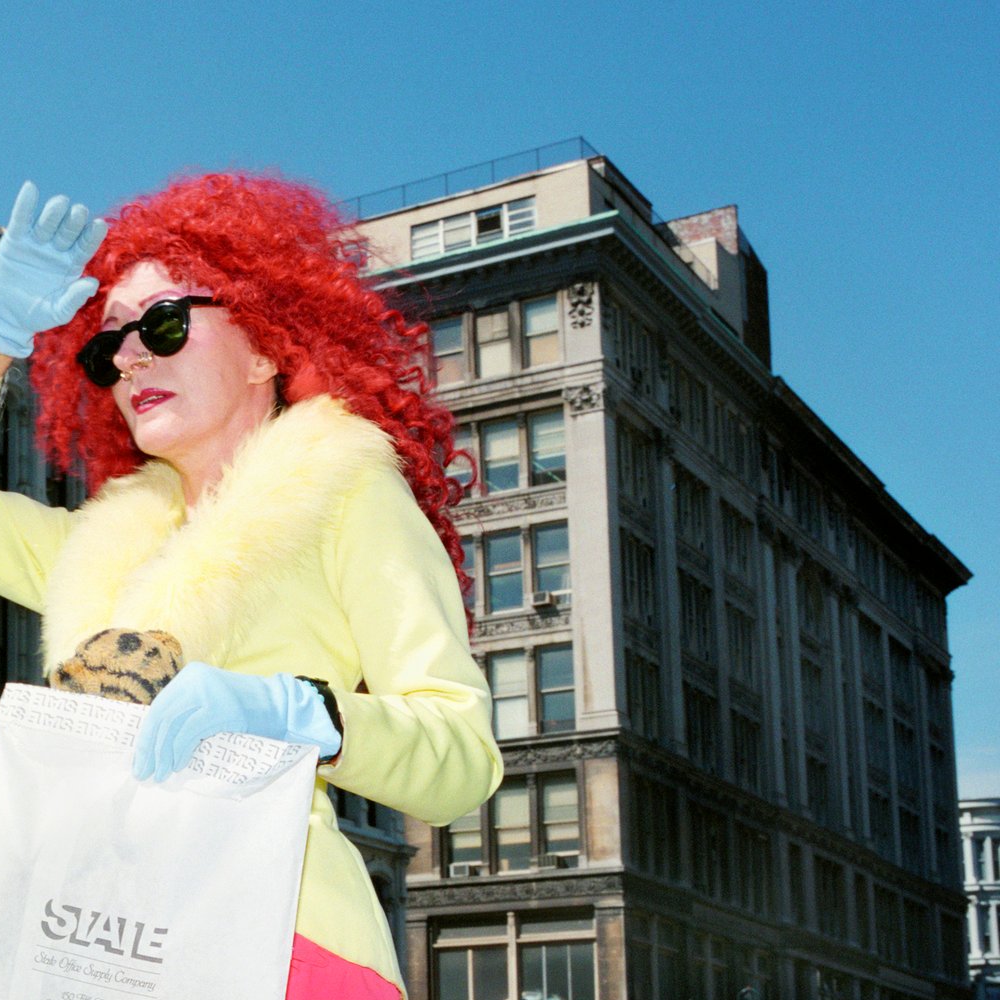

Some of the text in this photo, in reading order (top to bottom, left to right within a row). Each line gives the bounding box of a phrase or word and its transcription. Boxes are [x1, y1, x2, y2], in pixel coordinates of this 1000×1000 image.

[41, 899, 168, 964] STATE
[34, 951, 157, 992] State Office Supply Company
